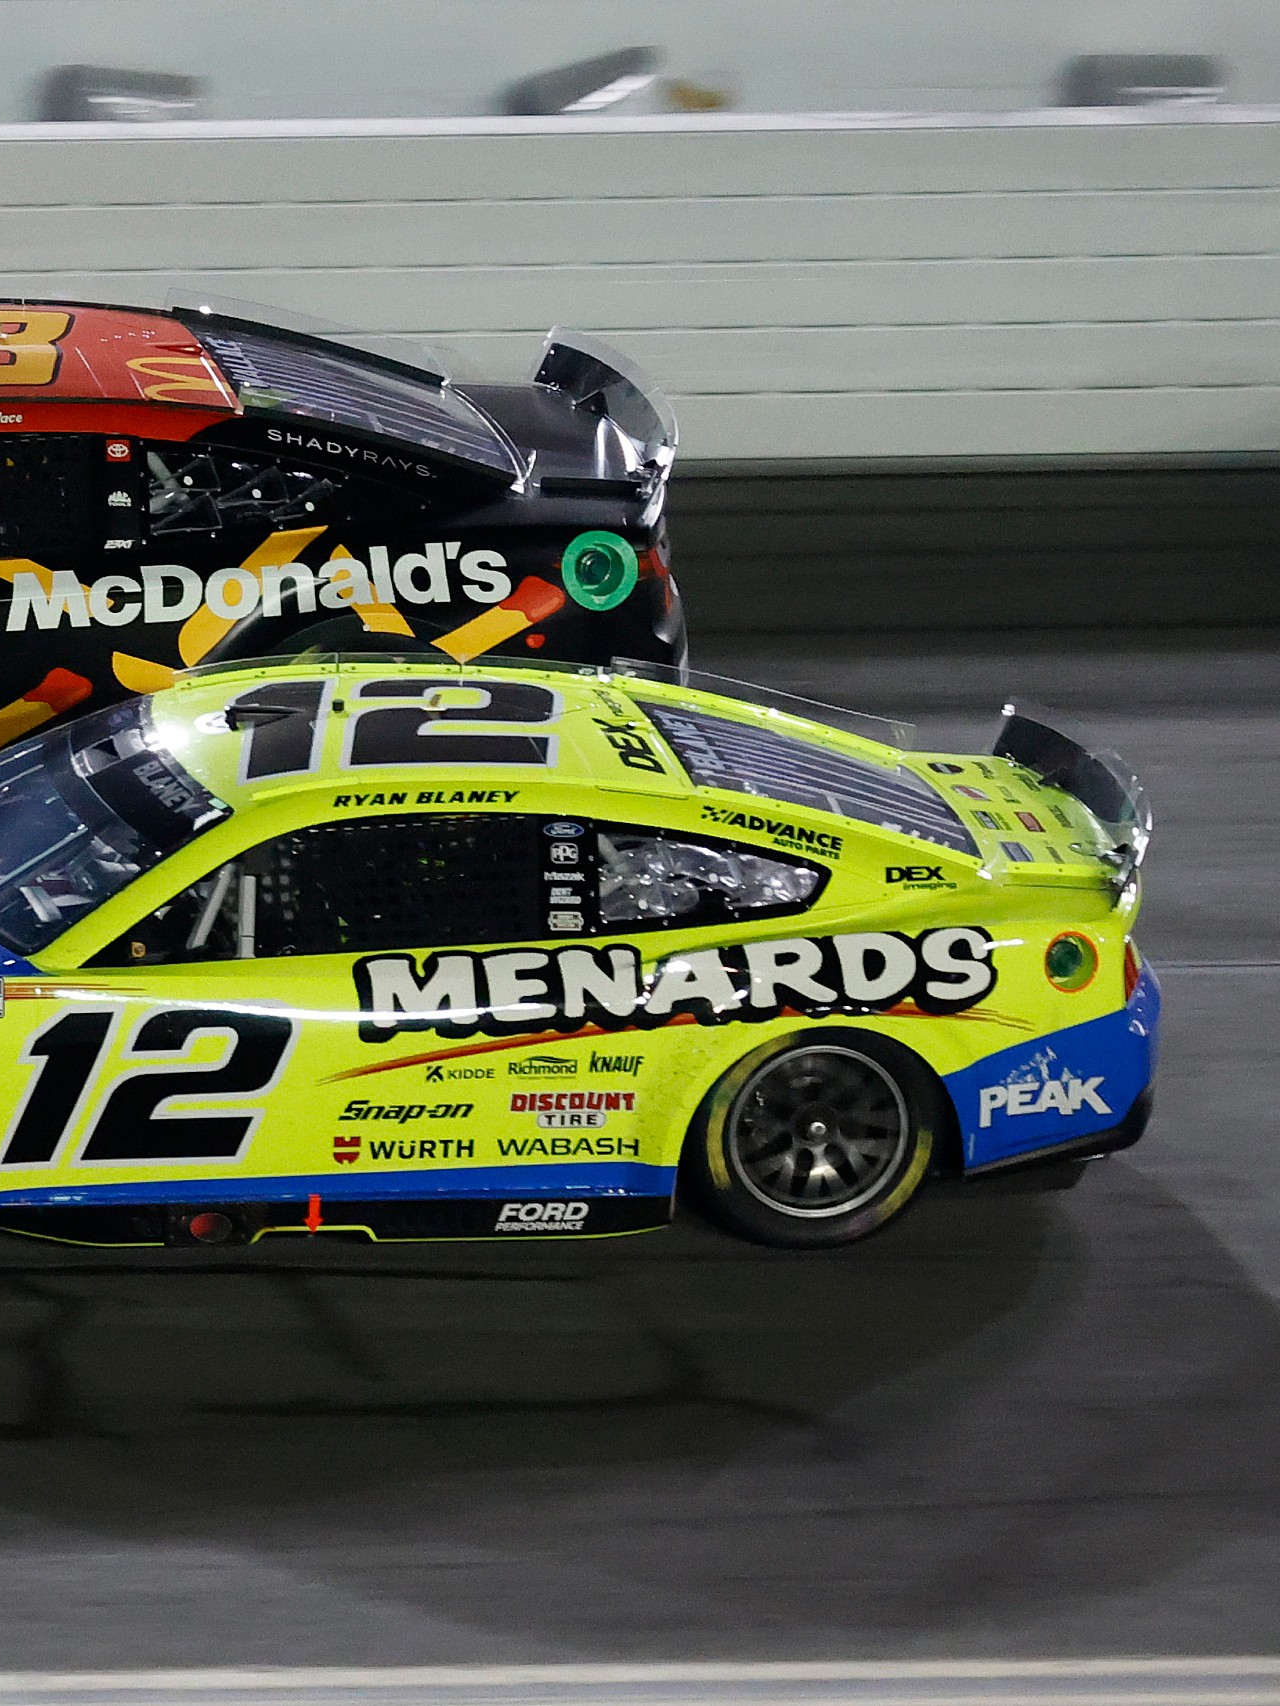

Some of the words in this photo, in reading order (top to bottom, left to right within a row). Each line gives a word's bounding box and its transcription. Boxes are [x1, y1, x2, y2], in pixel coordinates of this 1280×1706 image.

[5, 542, 513, 632] McDonald's
[226, 677, 565, 786] 12
[133, 761, 199, 814] BLANEY
[333, 793, 408, 808] RYAN
[416, 790, 521, 805] BLANEY
[728, 813, 844, 851] ADVANCE
[773, 837, 803, 850] AUTO
[805, 845, 840, 860] PARTS
[885, 866, 946, 883] DEX
[355, 927, 999, 1043] MENARDS
[447, 1068, 496, 1080] KIDDE
[508, 1060, 578, 1076] Richmond
[338, 1100, 475, 1125] Snap-on
[510, 1092, 637, 1112] DISCOUNT
[979, 1076, 1114, 1128] PEAK
[544, 1113, 599, 1126] TIRE
[496, 1137, 640, 1158] WABASH
[498, 1202, 590, 1222] FORD
[494, 1221, 586, 1233] PERFORMANCE
